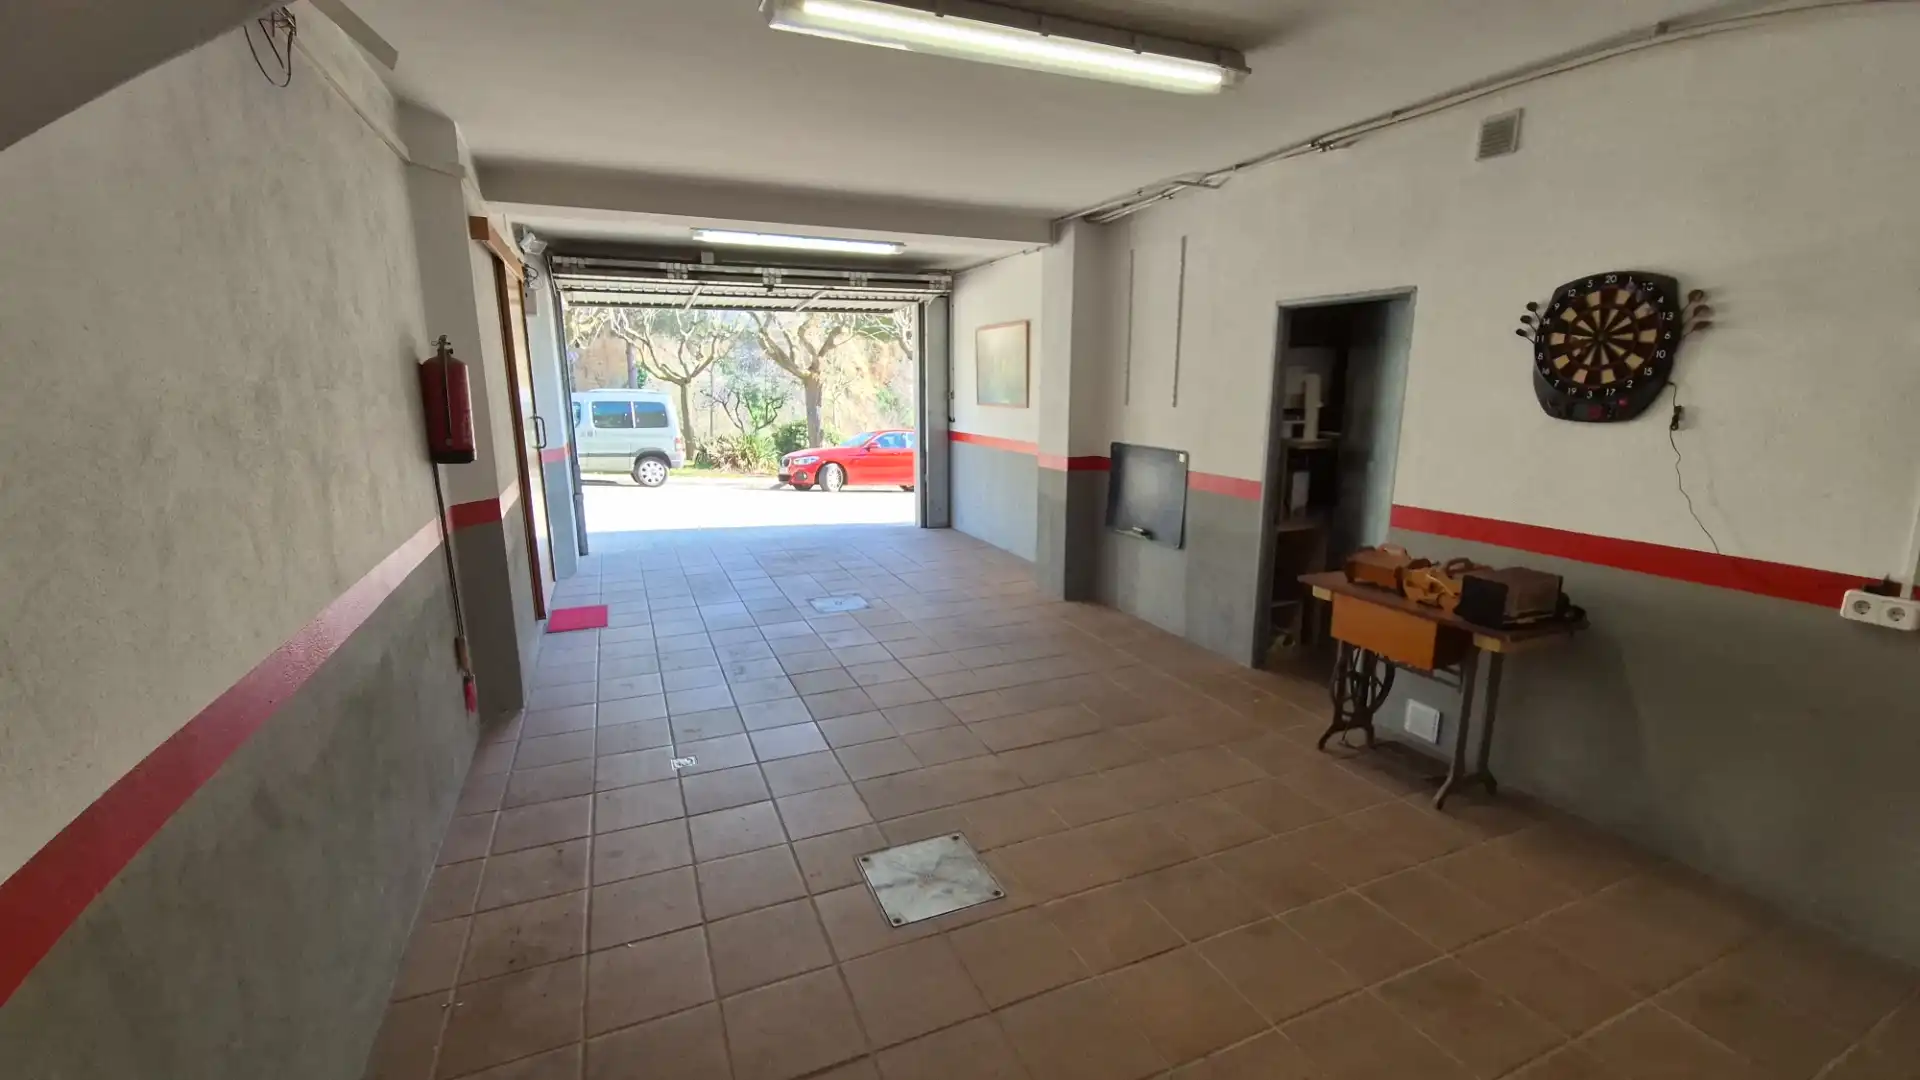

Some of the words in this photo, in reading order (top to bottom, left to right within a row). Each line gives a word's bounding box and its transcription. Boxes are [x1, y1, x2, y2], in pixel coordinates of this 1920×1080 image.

[1587, 279, 1594, 288] 5
[1605, 274, 1617, 284] 20
[1568, 289, 1577, 297] 12
[1657, 295, 1664, 303] 4
[1554, 302, 1560, 311] 9
[1662, 311, 1674, 320] 13
[1536, 335, 1545, 343] 11
[1664, 331, 1671, 340] 6
[1537, 352, 1544, 360] 8
[1655, 349, 1666, 359] 10
[1643, 366, 1653, 376] 15
[1553, 379, 1560, 387] 7
[1625, 379, 1633, 389] 2
[1567, 387, 1577, 396] 19
[1586, 390, 1593, 399] 3
[1605, 388, 1616, 396] 17
